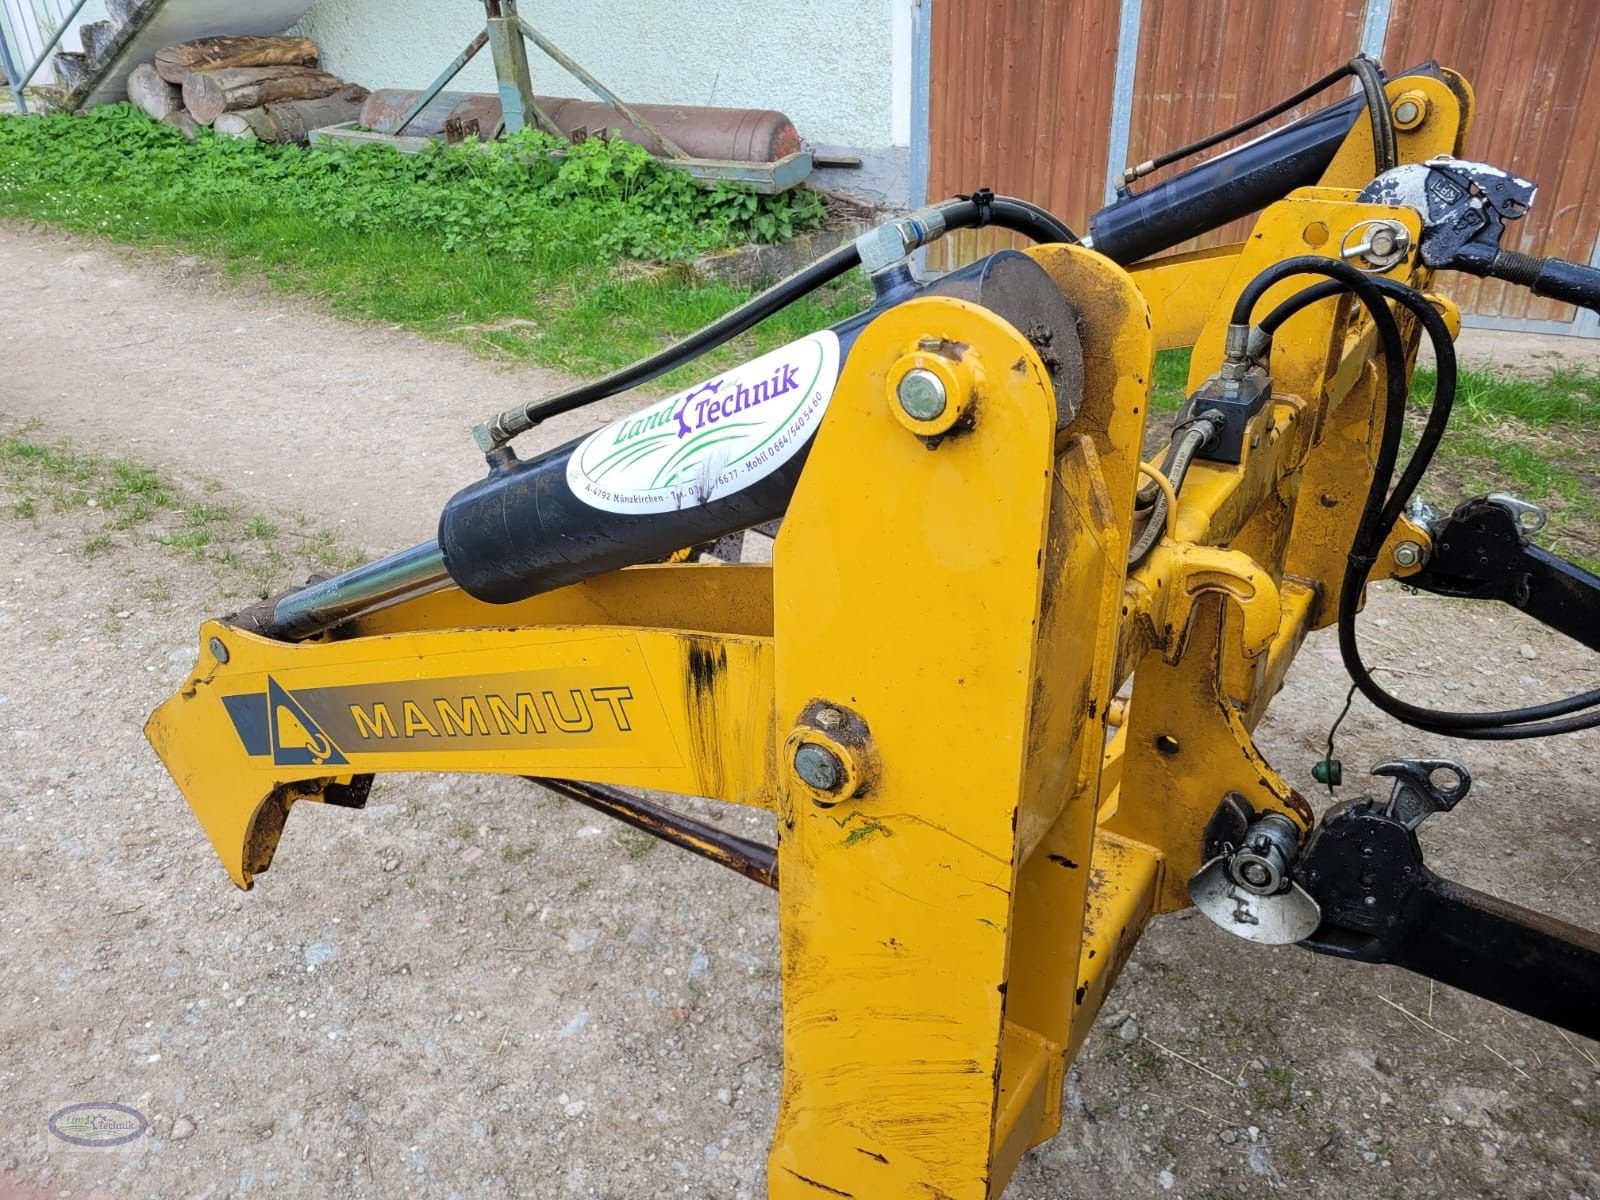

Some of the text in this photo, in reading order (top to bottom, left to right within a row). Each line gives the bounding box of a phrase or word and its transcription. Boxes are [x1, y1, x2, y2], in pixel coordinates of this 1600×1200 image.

[613, 363, 799, 445] Land Technik
[585, 484, 611, 500] A-4792
[614, 494, 664, 503] Münzkirchen
[746, 451, 768, 472] Mobil
[348, 686, 634, 739] MAMMUT
